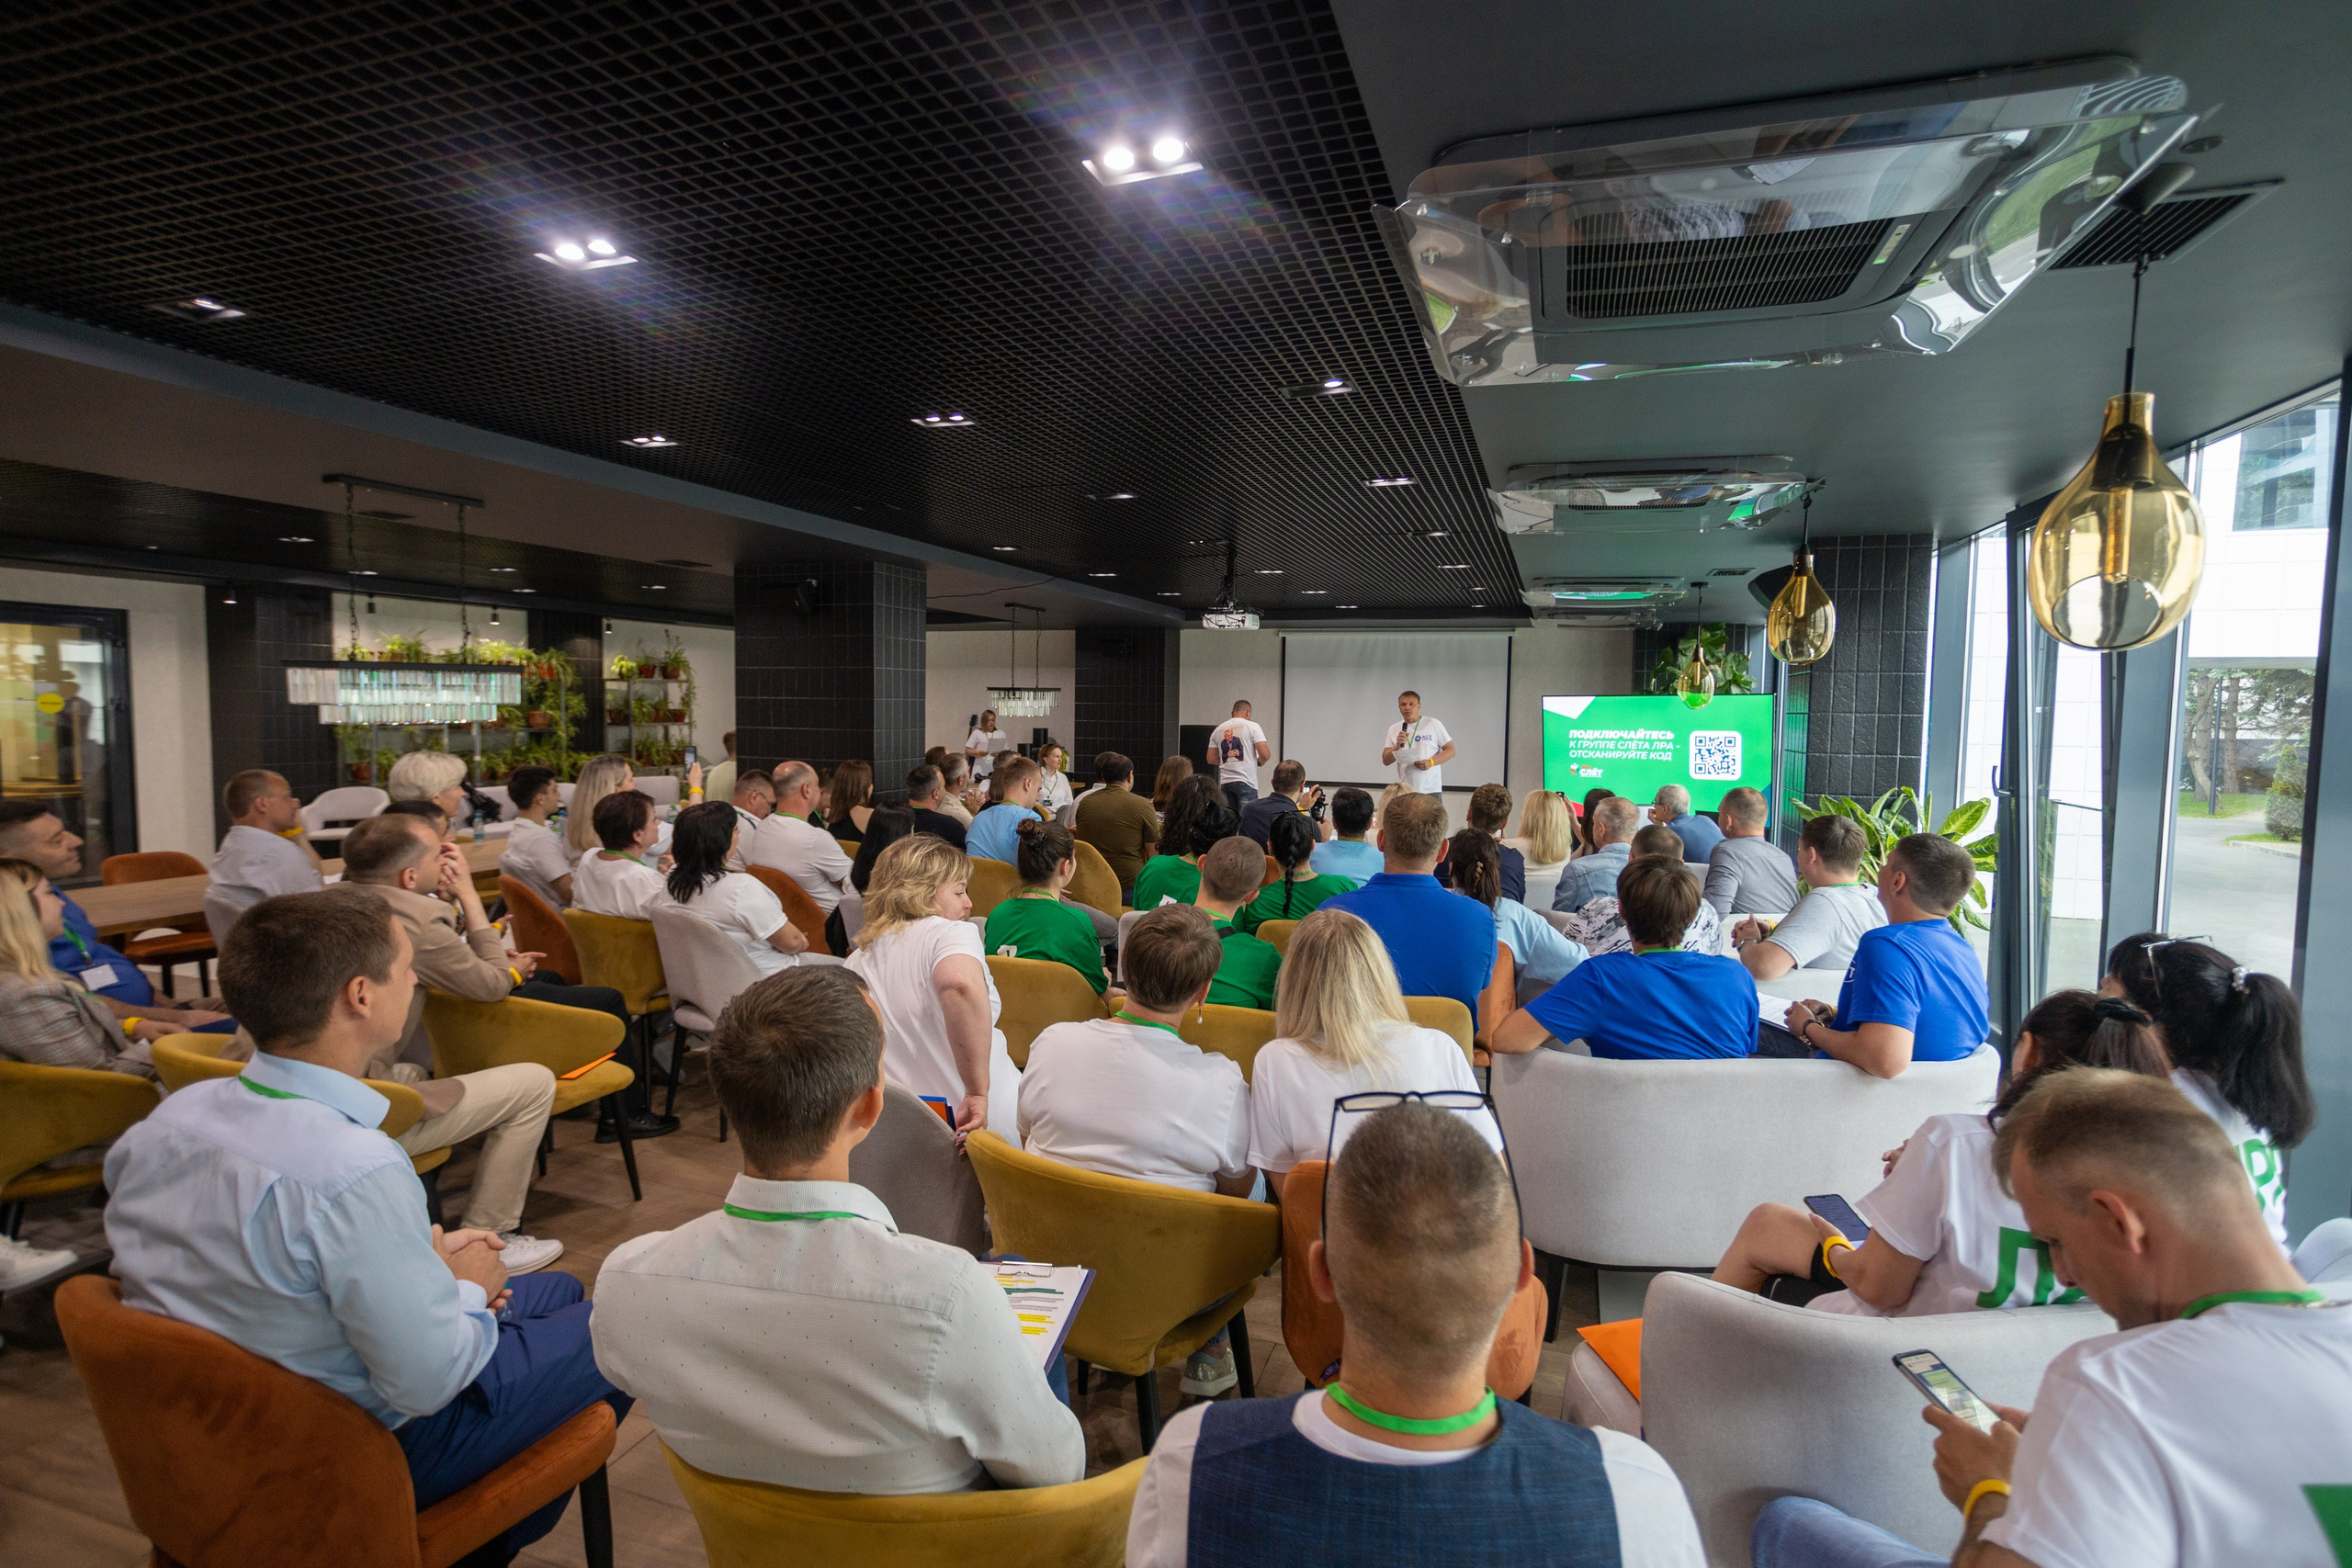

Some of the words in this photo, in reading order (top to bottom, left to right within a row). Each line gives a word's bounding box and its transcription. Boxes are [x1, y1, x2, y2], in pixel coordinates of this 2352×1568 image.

[1569, 728, 1675, 739] ПОДКЛЮЧАЙТЕСЬ
[1569, 740, 1576, 749] К
[1577, 740, 1616, 750] ГРУППЕ
[1617, 740, 1651, 750] СЛЁТА
[1651, 741, 1674, 750] ЛРА
[1569, 750, 1648, 760] ОТСКАНИРУЙТЕ
[1649, 751, 1673, 761] КОД
[1579, 767, 1604, 777] СЛЁТ
